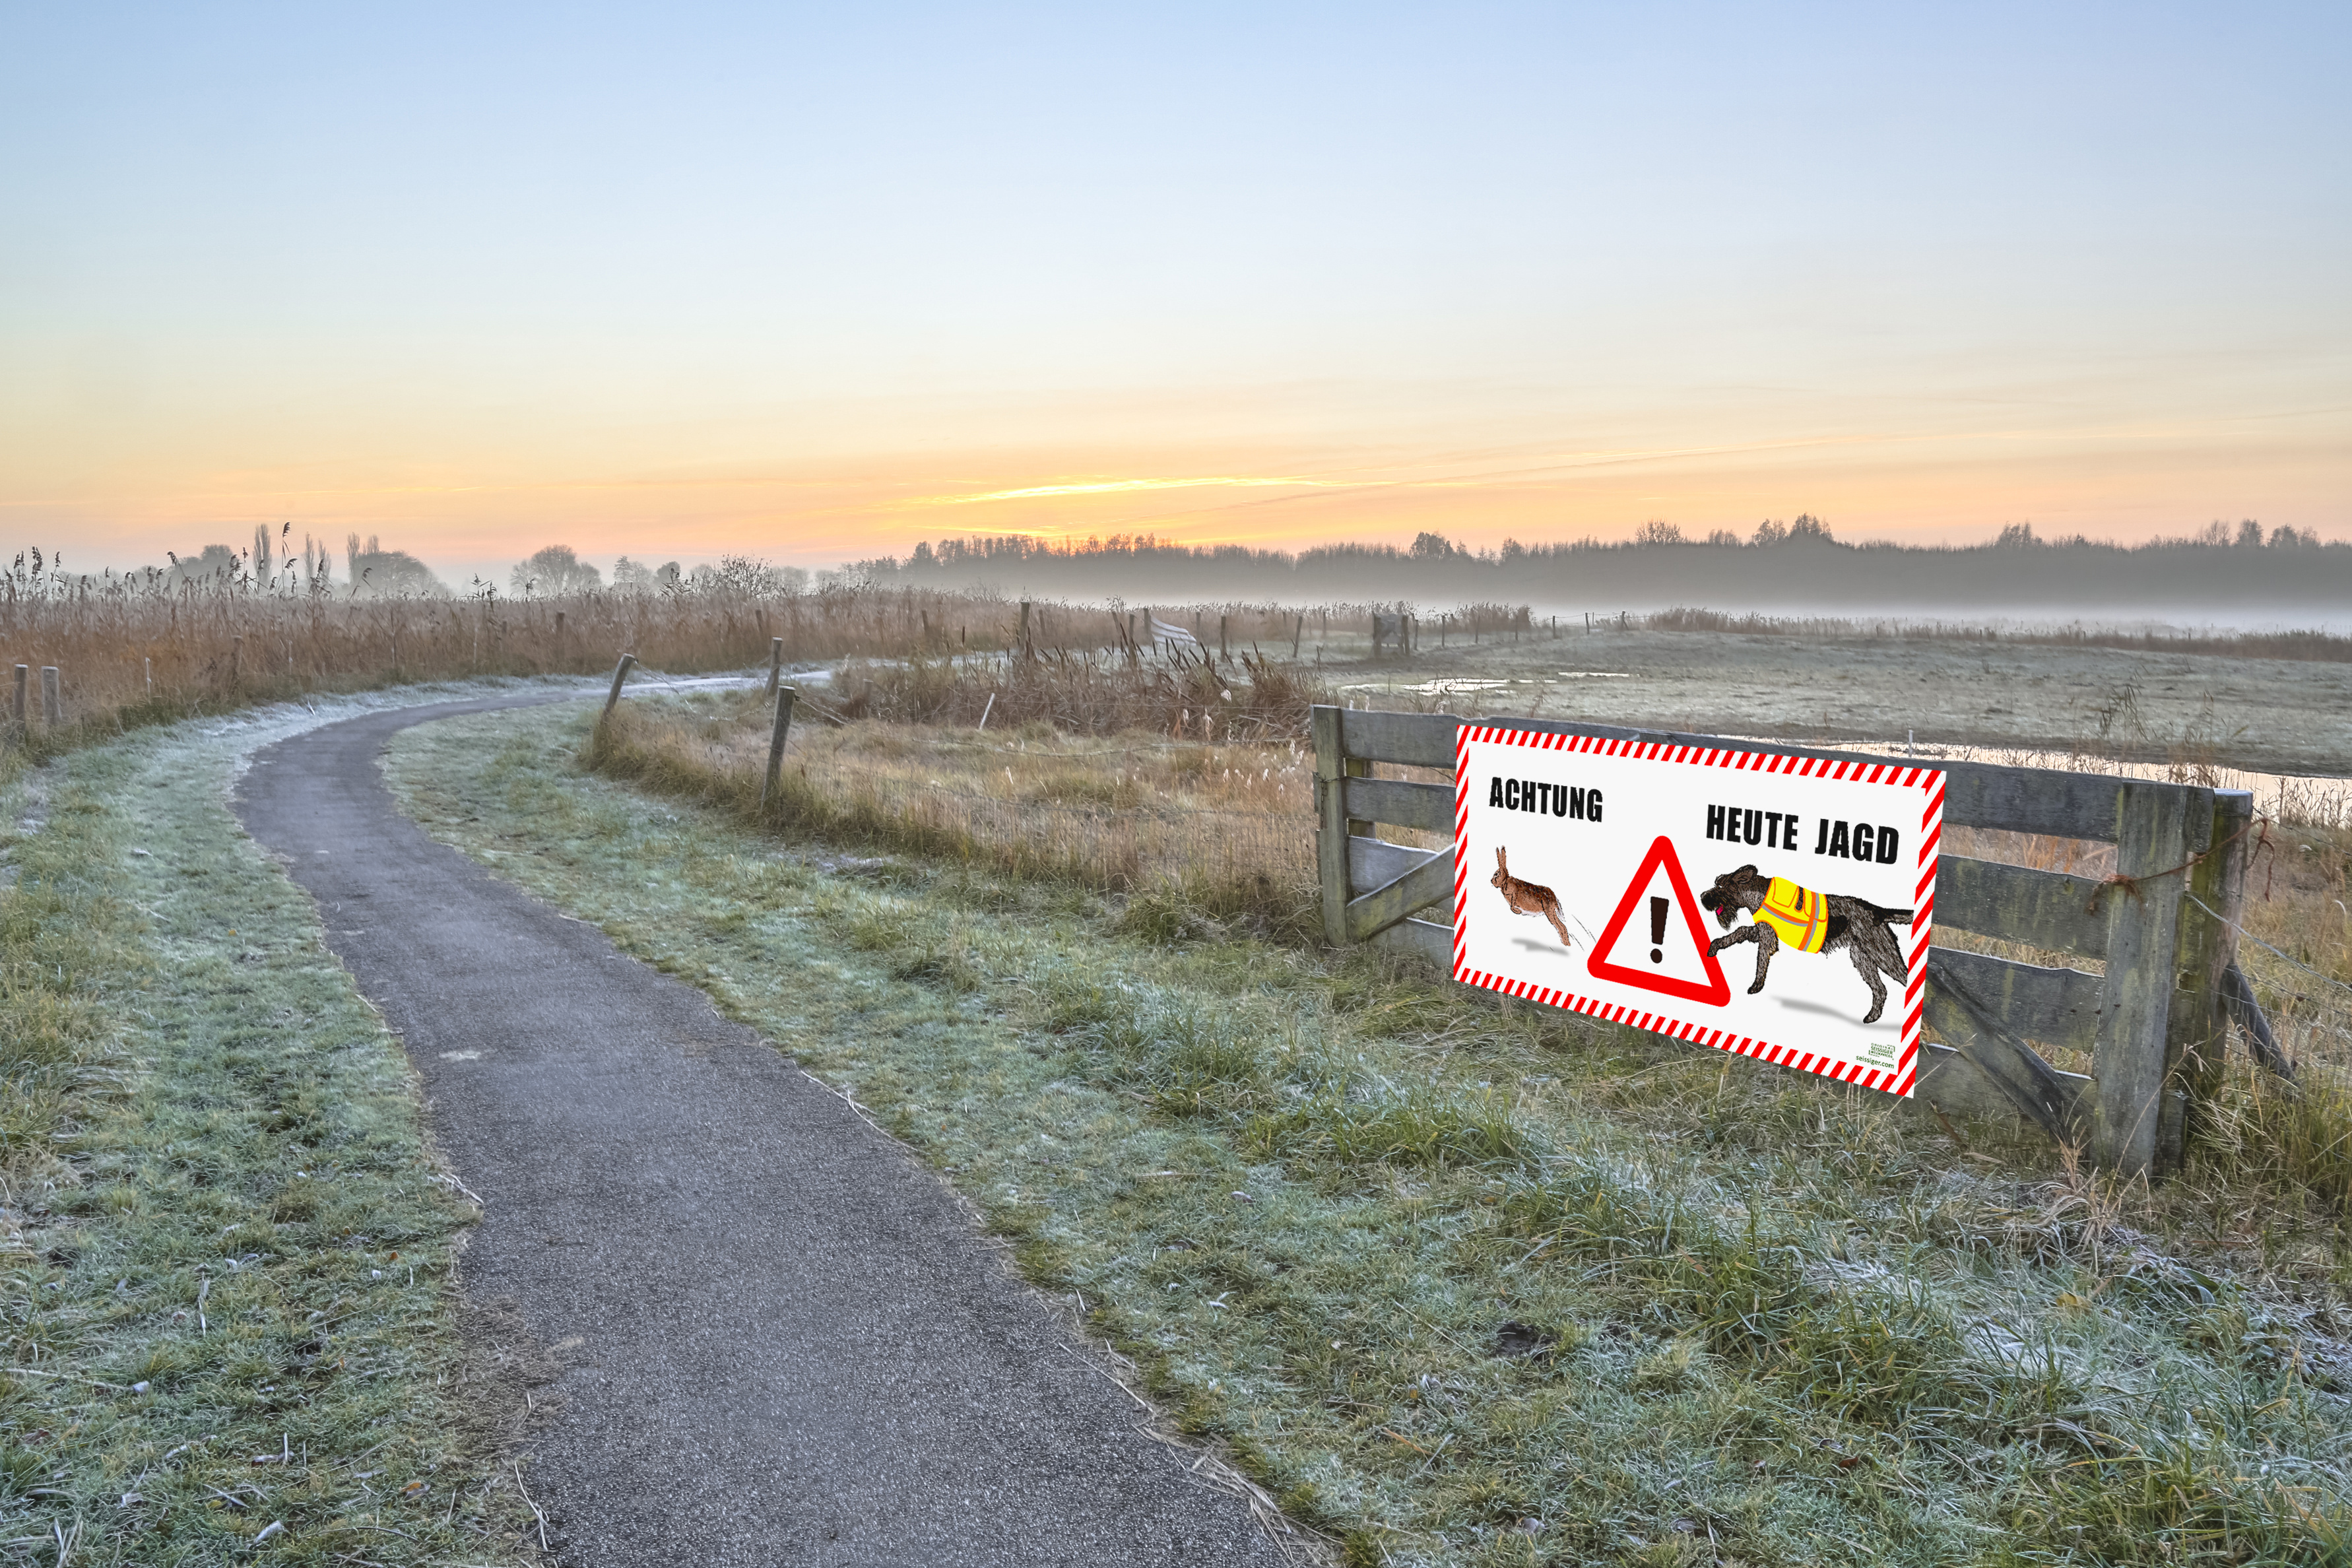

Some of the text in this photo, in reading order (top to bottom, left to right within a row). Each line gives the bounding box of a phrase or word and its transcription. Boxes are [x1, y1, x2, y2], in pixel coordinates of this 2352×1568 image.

[1489, 777, 1603, 823] ACHTUNG
[1706, 804, 1899, 865] HEUTE JAGD
[1856, 1055, 1894, 1069] seissiger.com
[1871, 1046, 1893, 1055] SEISSIGER
